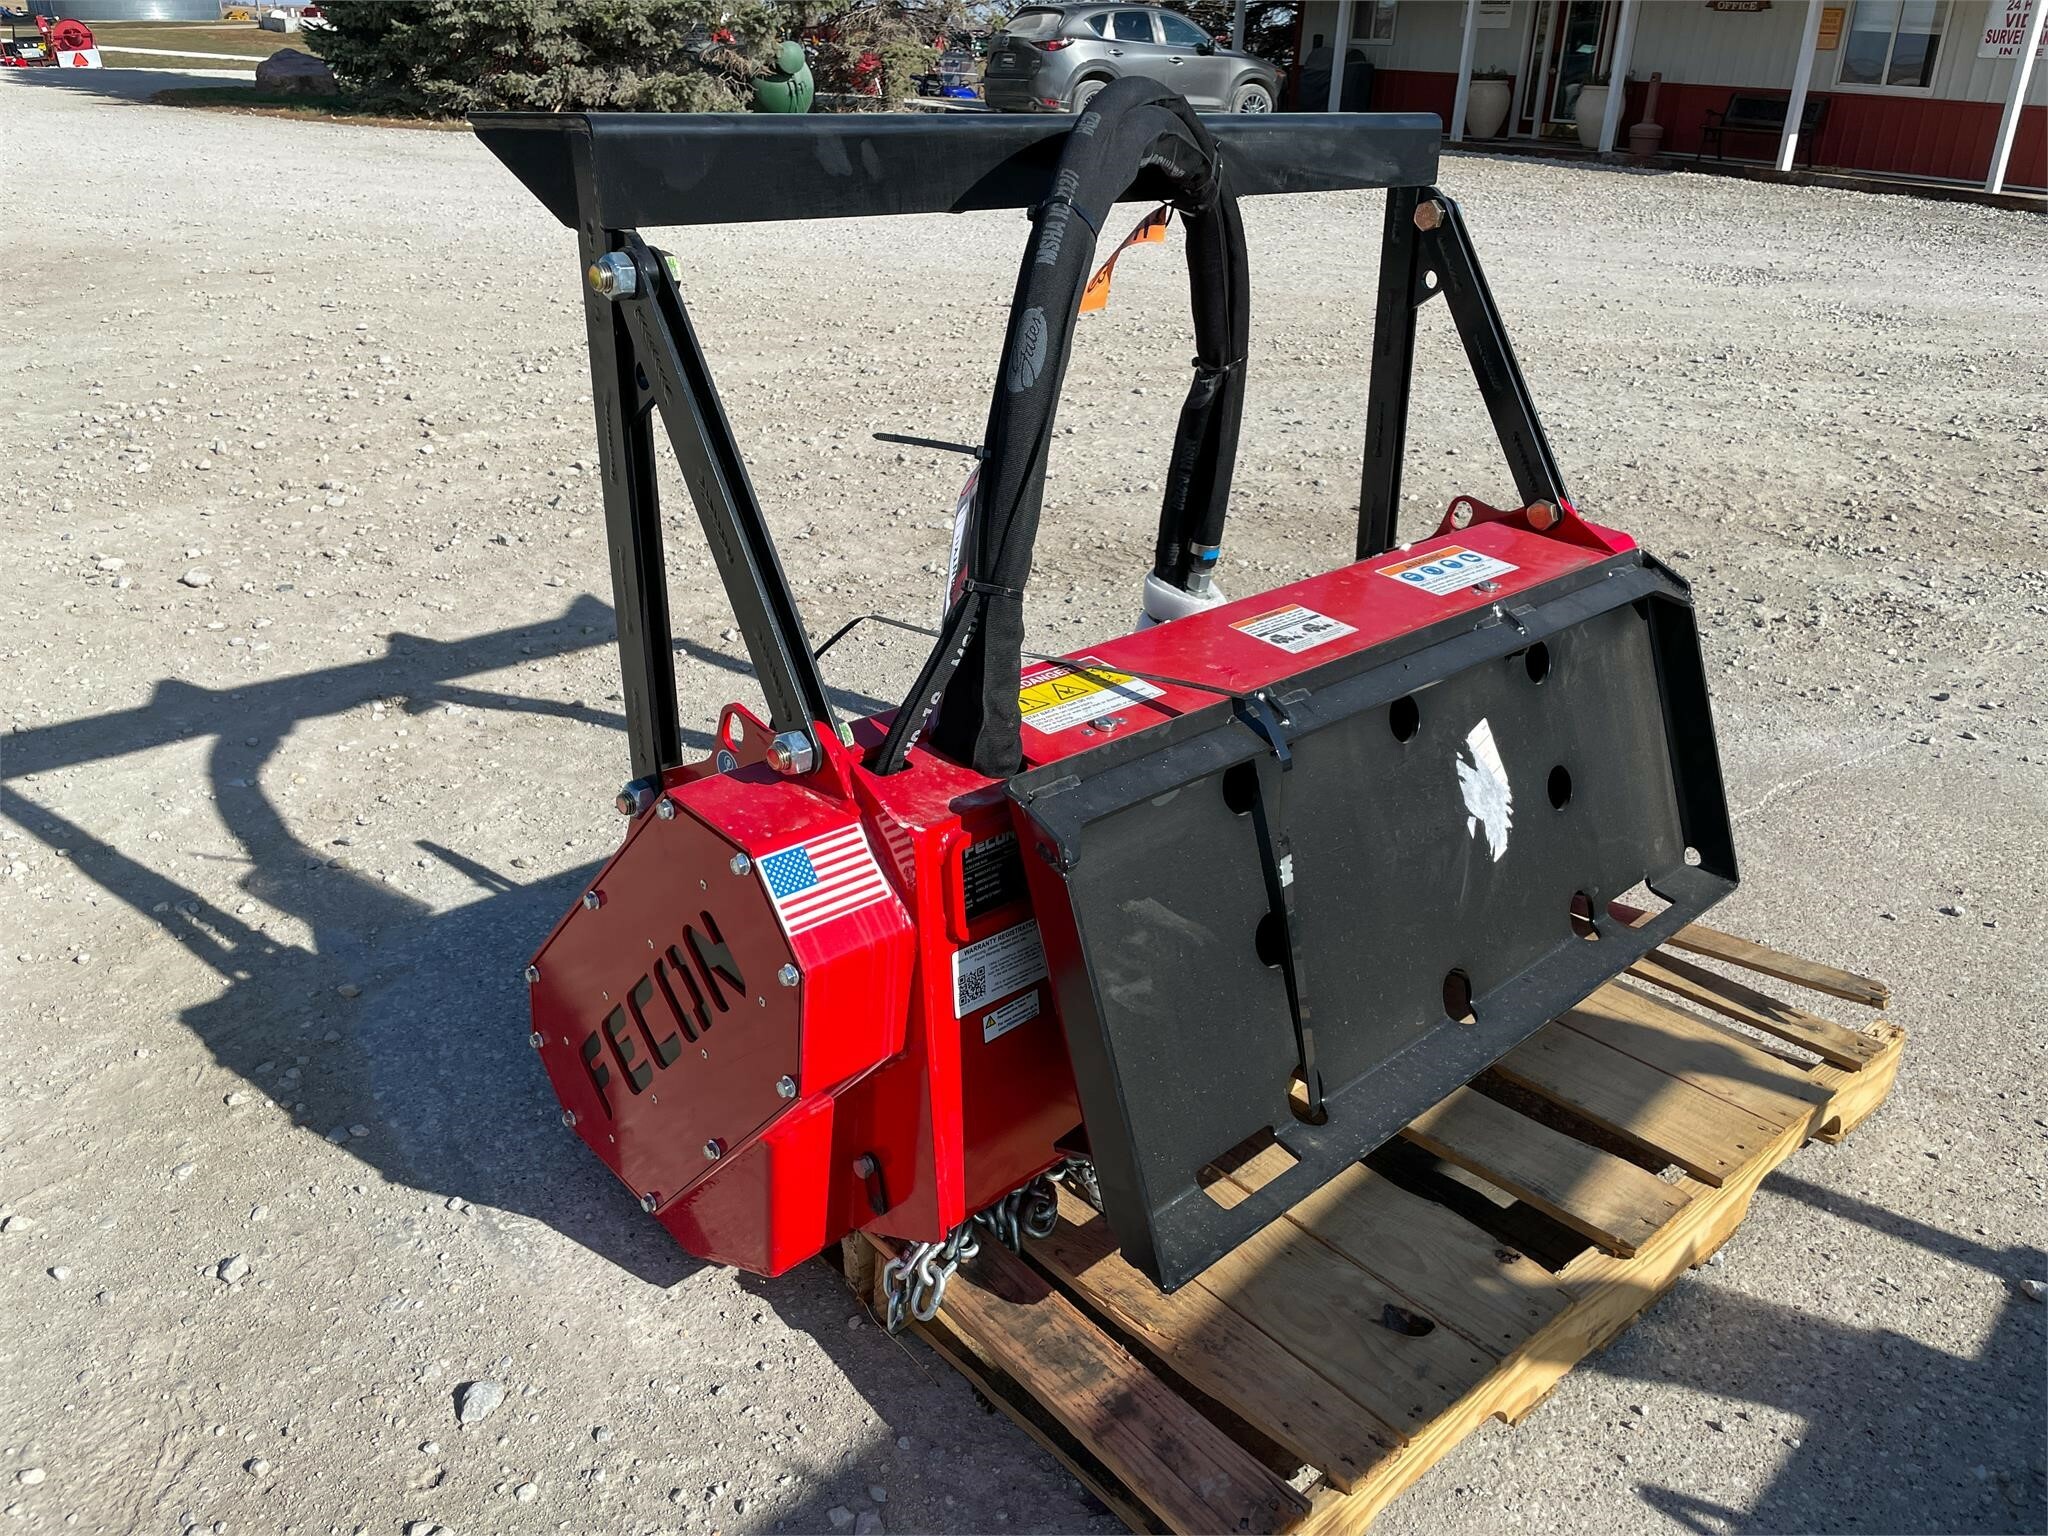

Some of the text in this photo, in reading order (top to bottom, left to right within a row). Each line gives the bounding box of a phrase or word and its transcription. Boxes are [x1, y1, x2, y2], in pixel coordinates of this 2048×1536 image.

[1717, 1, 1758, 10] OFFICE
[2007, 0, 2021, 11] 24
[1999, 47, 2013, 55] IN
[1035, 222, 1067, 266] MSHA
[1011, 316, 1042, 387] Gates
[1023, 667, 1075, 687] DANGER
[964, 937, 998, 956] WARRANTY
[997, 922, 1036, 940] REGISTRATIO
[579, 910, 747, 1121] FECON
